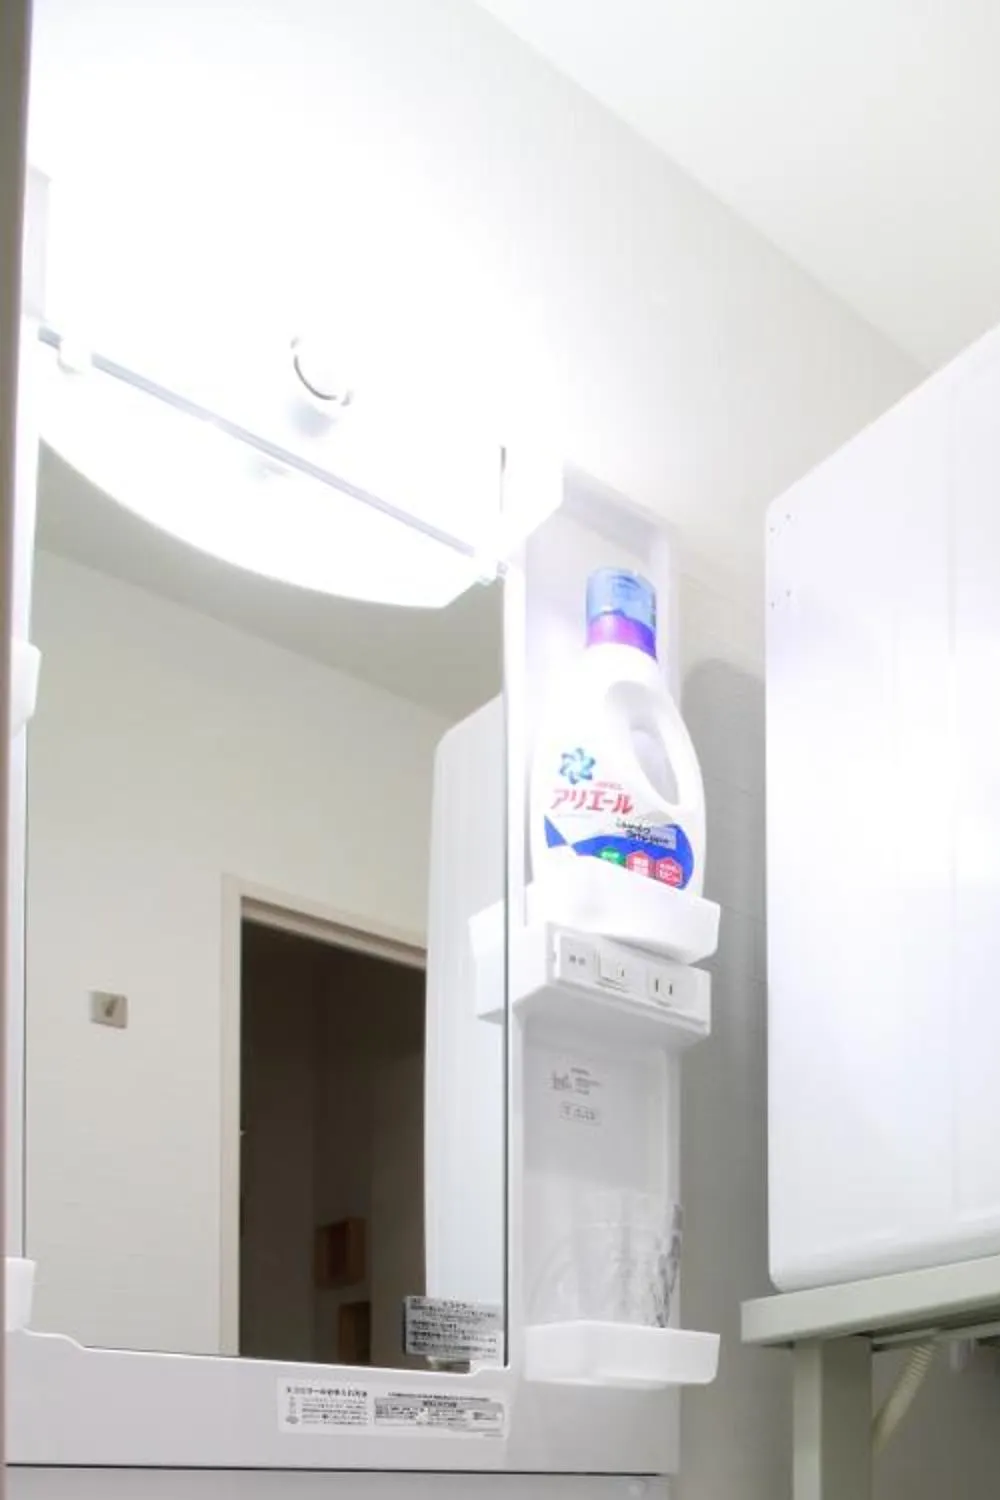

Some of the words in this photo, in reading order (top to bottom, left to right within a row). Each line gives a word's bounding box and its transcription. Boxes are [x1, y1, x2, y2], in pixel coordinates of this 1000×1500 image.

[550, 788, 634, 814] アリエール
